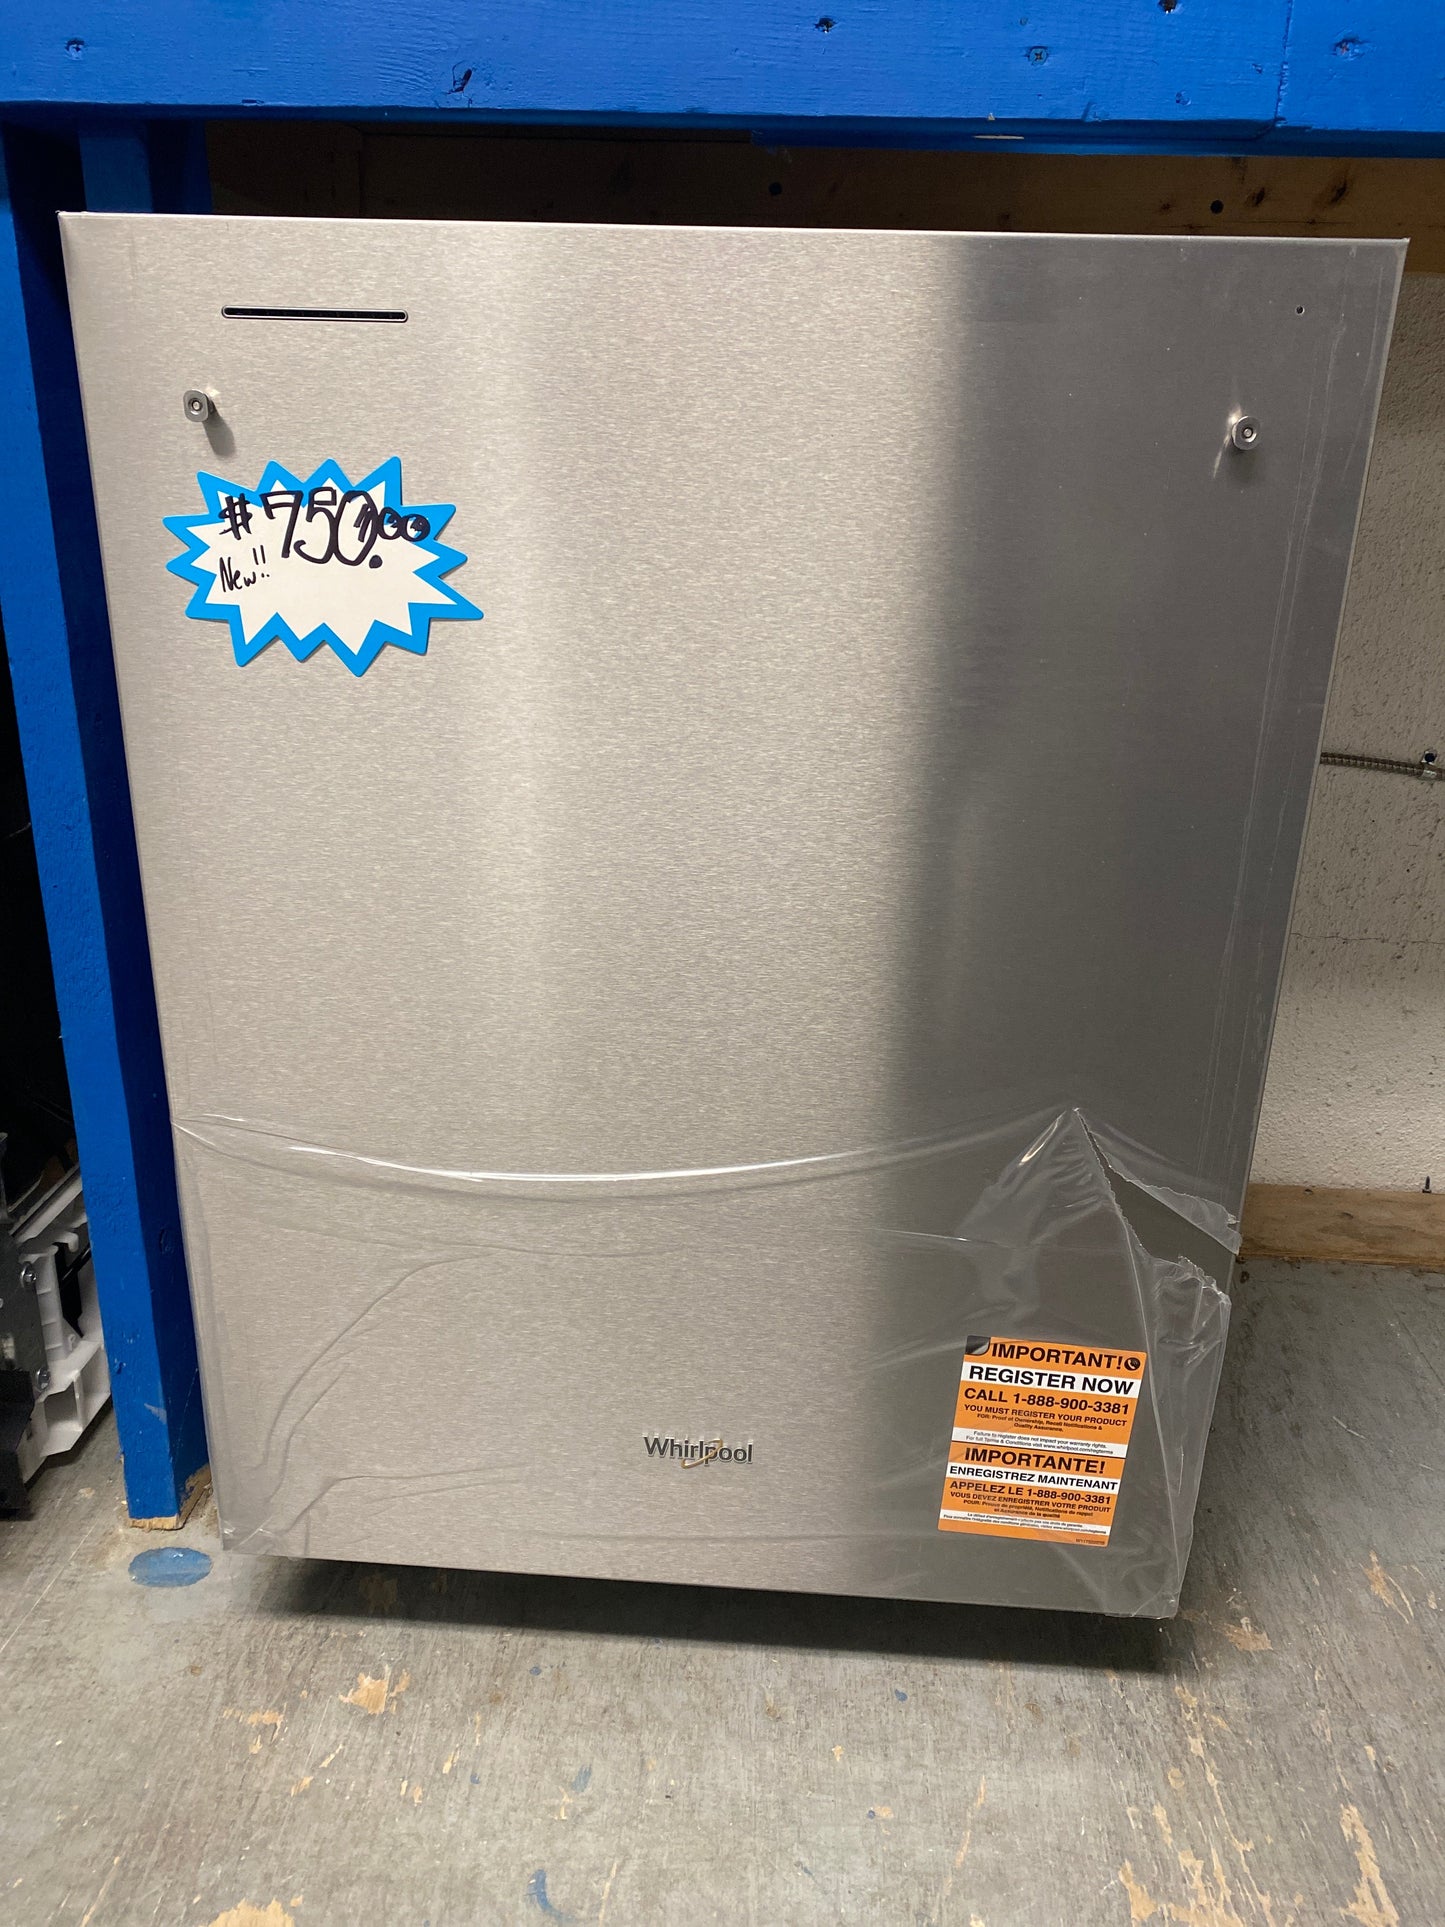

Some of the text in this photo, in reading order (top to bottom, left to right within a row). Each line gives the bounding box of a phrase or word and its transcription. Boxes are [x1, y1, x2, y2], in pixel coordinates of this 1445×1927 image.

[219, 544, 271, 593] New!!
[991, 1343, 1124, 1370] IMPORTANT!
[969, 1365, 1134, 1395] REGISTER NOW
[964, 1388, 1129, 1415] CALL 1-888-900-3381
[1012, 1409, 1055, 1419] REGISTER
[1058, 1414, 1082, 1422] YOUR
[1084, 1416, 1127, 1426] PRODUCT
[642, 1436, 754, 1466] Whirlpool
[964, 1447, 1106, 1474] IMPORTANTE!
[950, 1465, 1118, 1490] ENREGISTREZ MAINTENANT
[950, 1480, 1111, 1504] APPELEZ LE 1-888-900-3381
[998, 1496, 1050, 1506] ENREGISTRER
